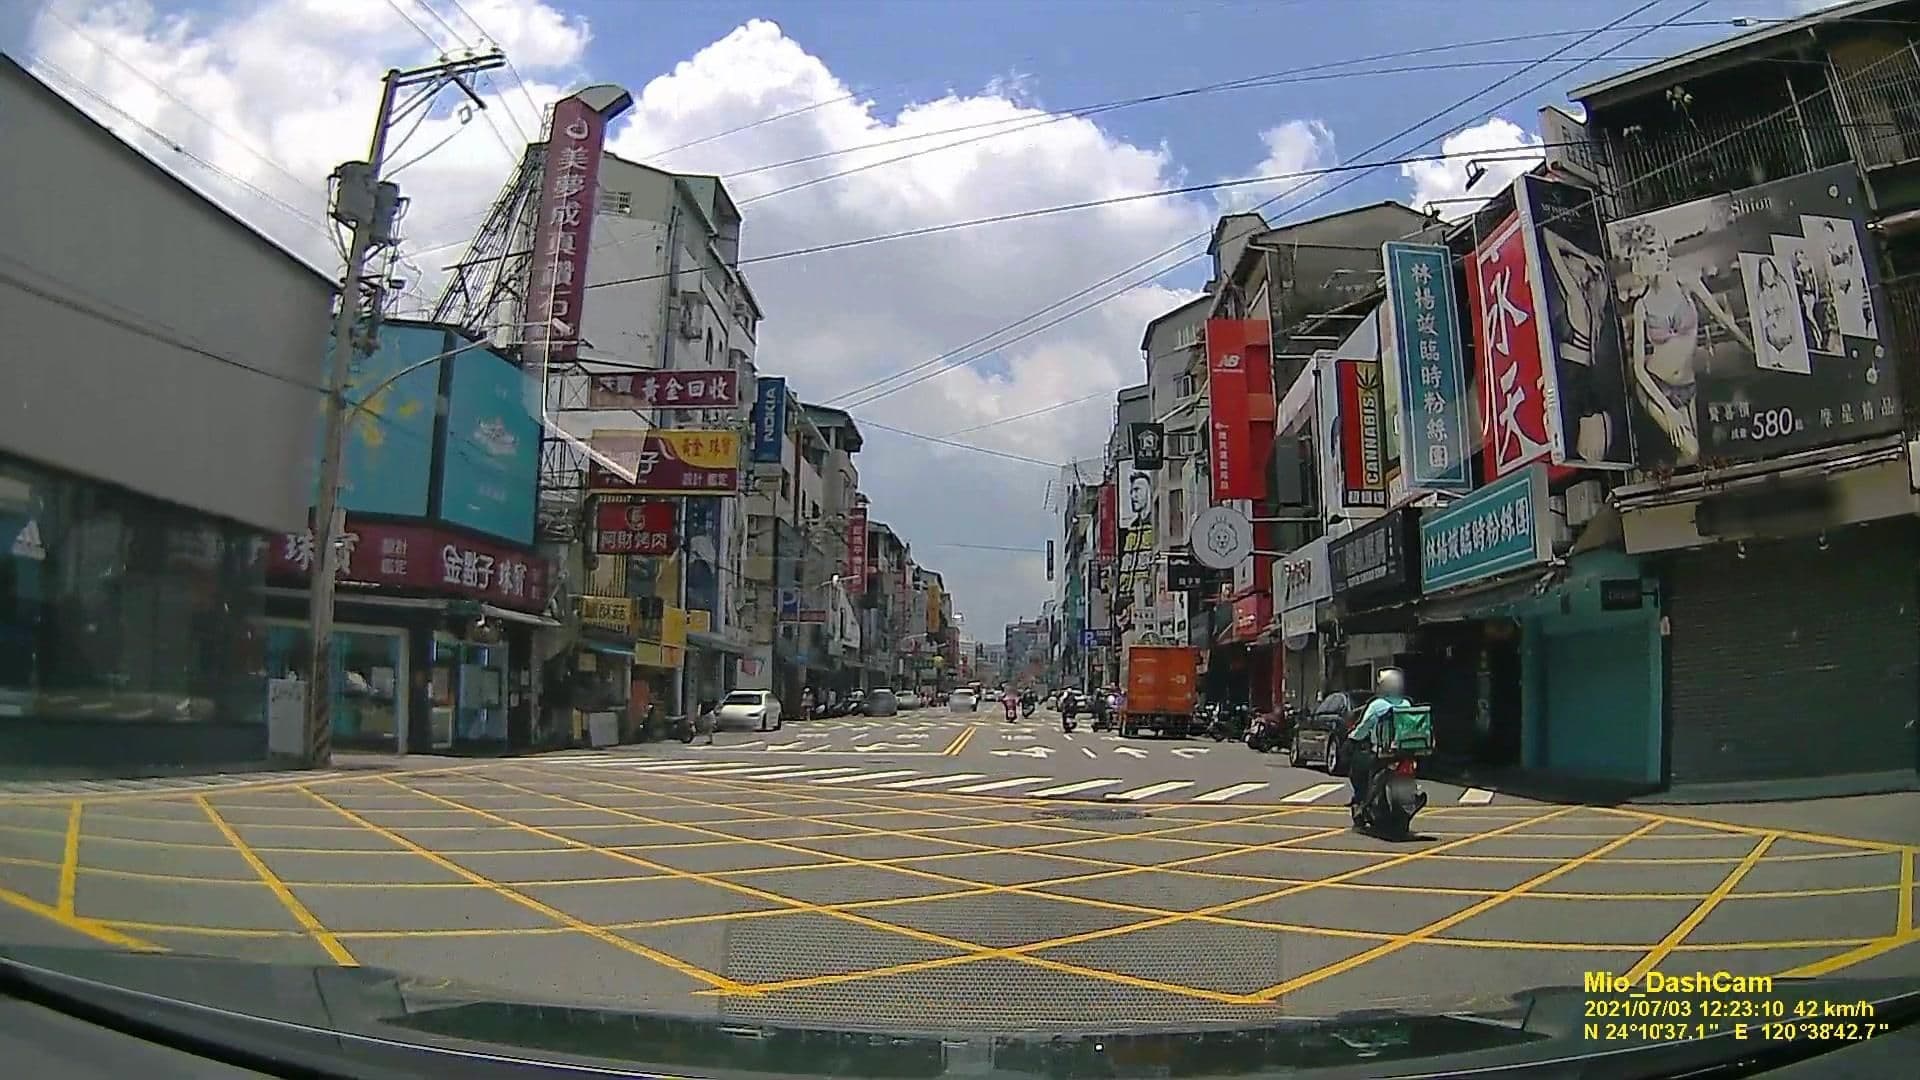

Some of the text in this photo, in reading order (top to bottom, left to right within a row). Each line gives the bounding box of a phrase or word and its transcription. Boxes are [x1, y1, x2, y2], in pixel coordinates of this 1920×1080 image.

[765, 387, 776, 442] NOKIA
[1751, 407, 1792, 440] 580
[1362, 396, 1379, 485] CANNABIS
[601, 530, 668, 550] 阿財烤肉
